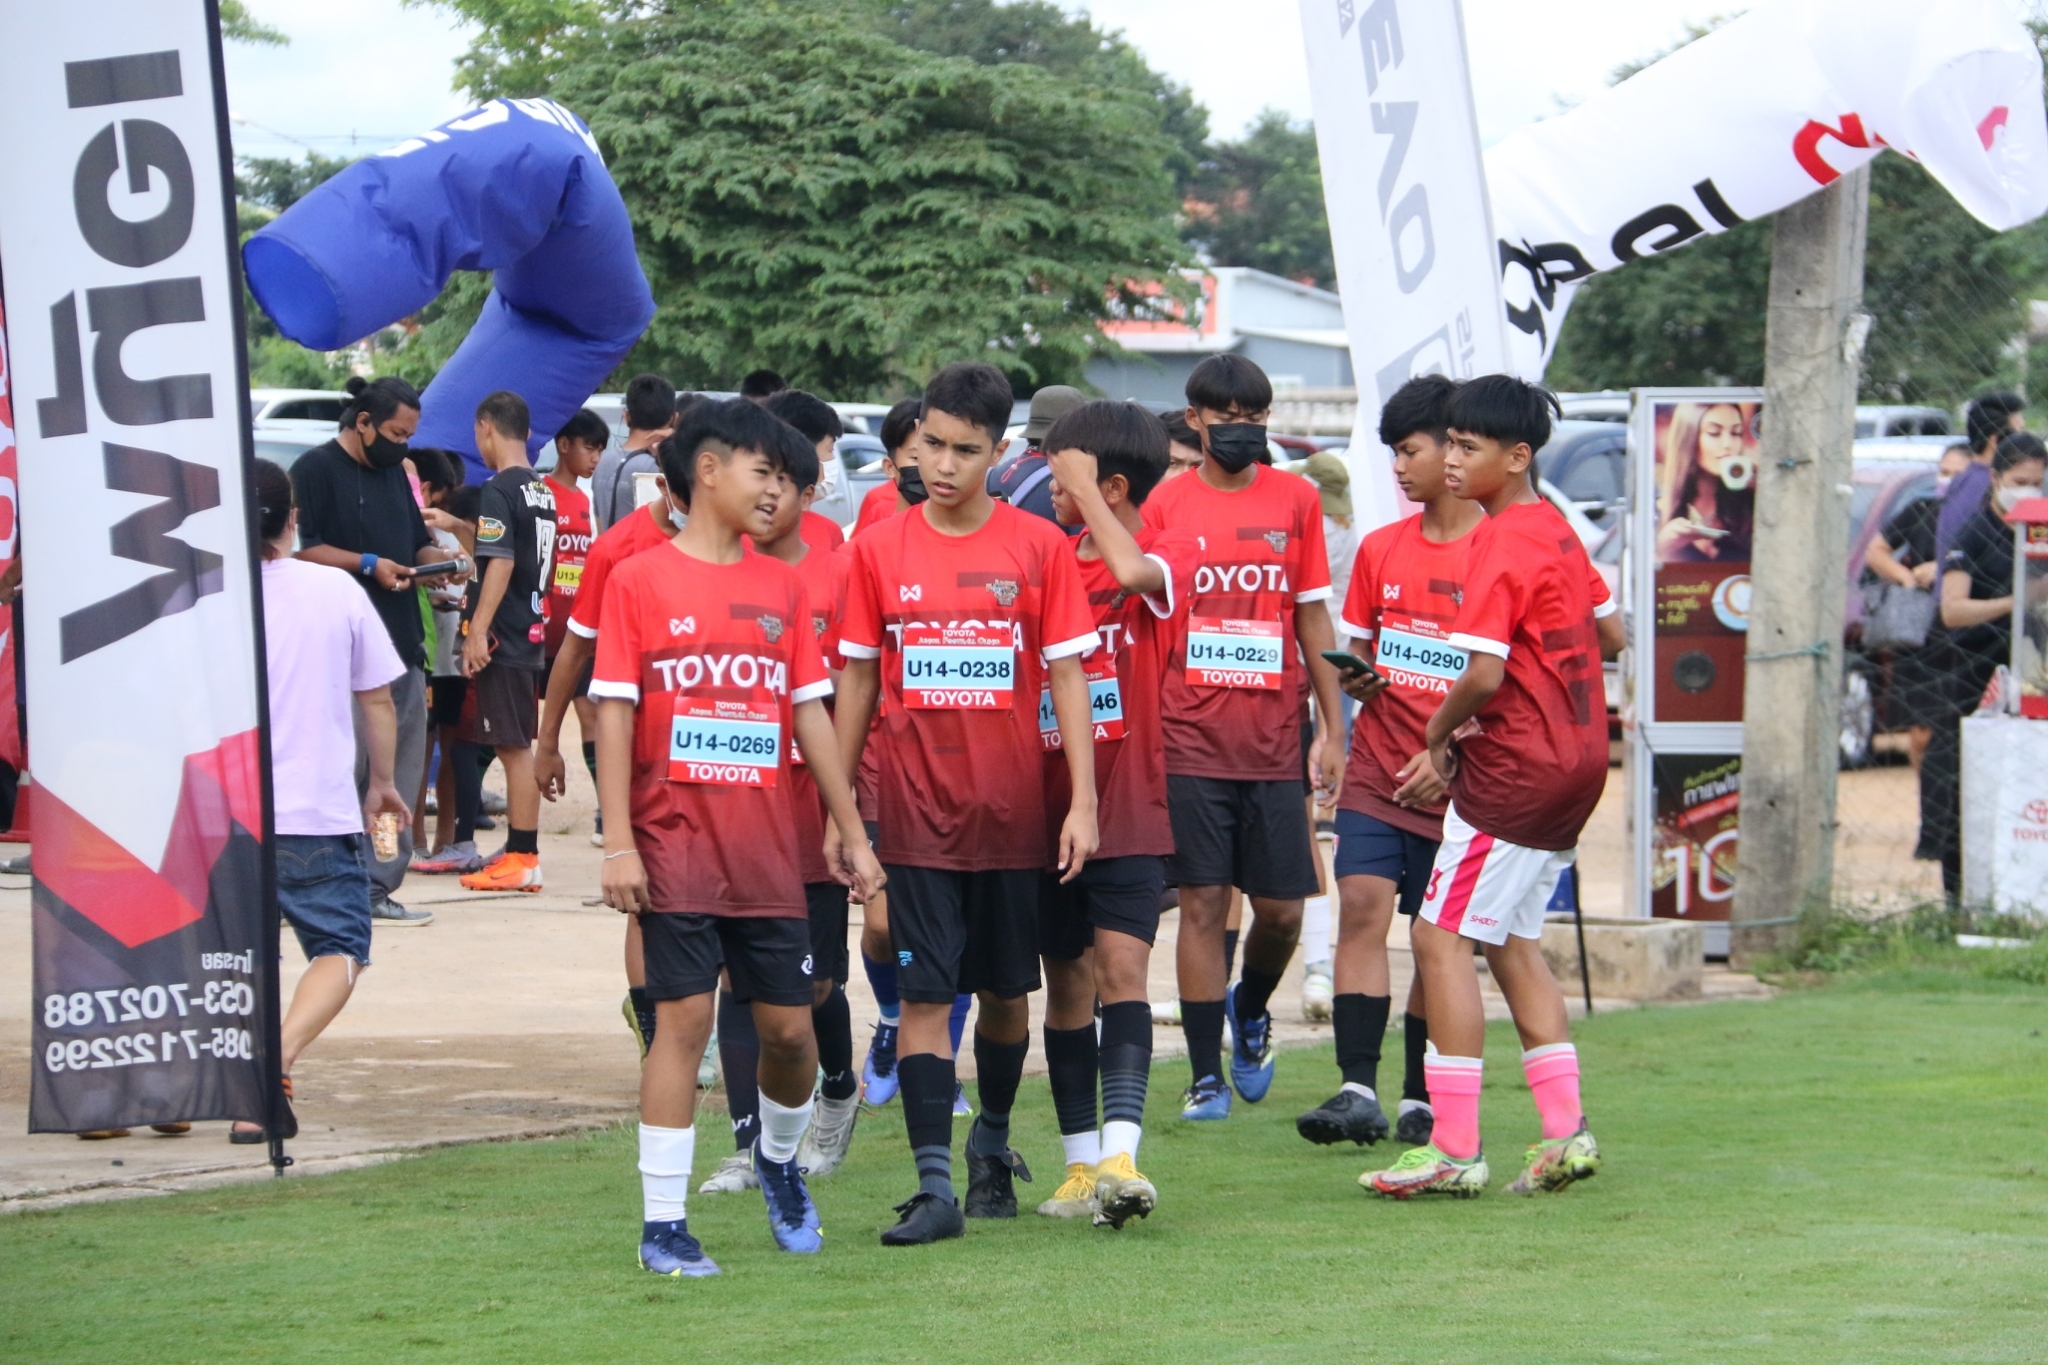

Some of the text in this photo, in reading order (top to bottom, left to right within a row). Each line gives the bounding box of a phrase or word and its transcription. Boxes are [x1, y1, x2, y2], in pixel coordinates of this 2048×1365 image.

[1221, 619, 1250, 628] TOYOTA
[1411, 618, 1439, 629] TOYOTA
[942, 629, 976, 638] TOYOTA
[1191, 644, 1279, 663] U14-0229
[1381, 640, 1465, 671] U14-0290
[652, 653, 787, 696] TOYOTA
[907, 660, 1011, 678] U14-0238
[1200, 670, 1266, 686] TOYOTA
[1388, 669, 1449, 694] TOYOTA
[715, 701, 747, 710] TOYOTA
[920, 690, 996, 706] TOYOTA
[675, 730, 776, 755] U14-0269
[687, 763, 761, 784] TOYOTA
[1470, 914, 1499, 927] SHOOT
